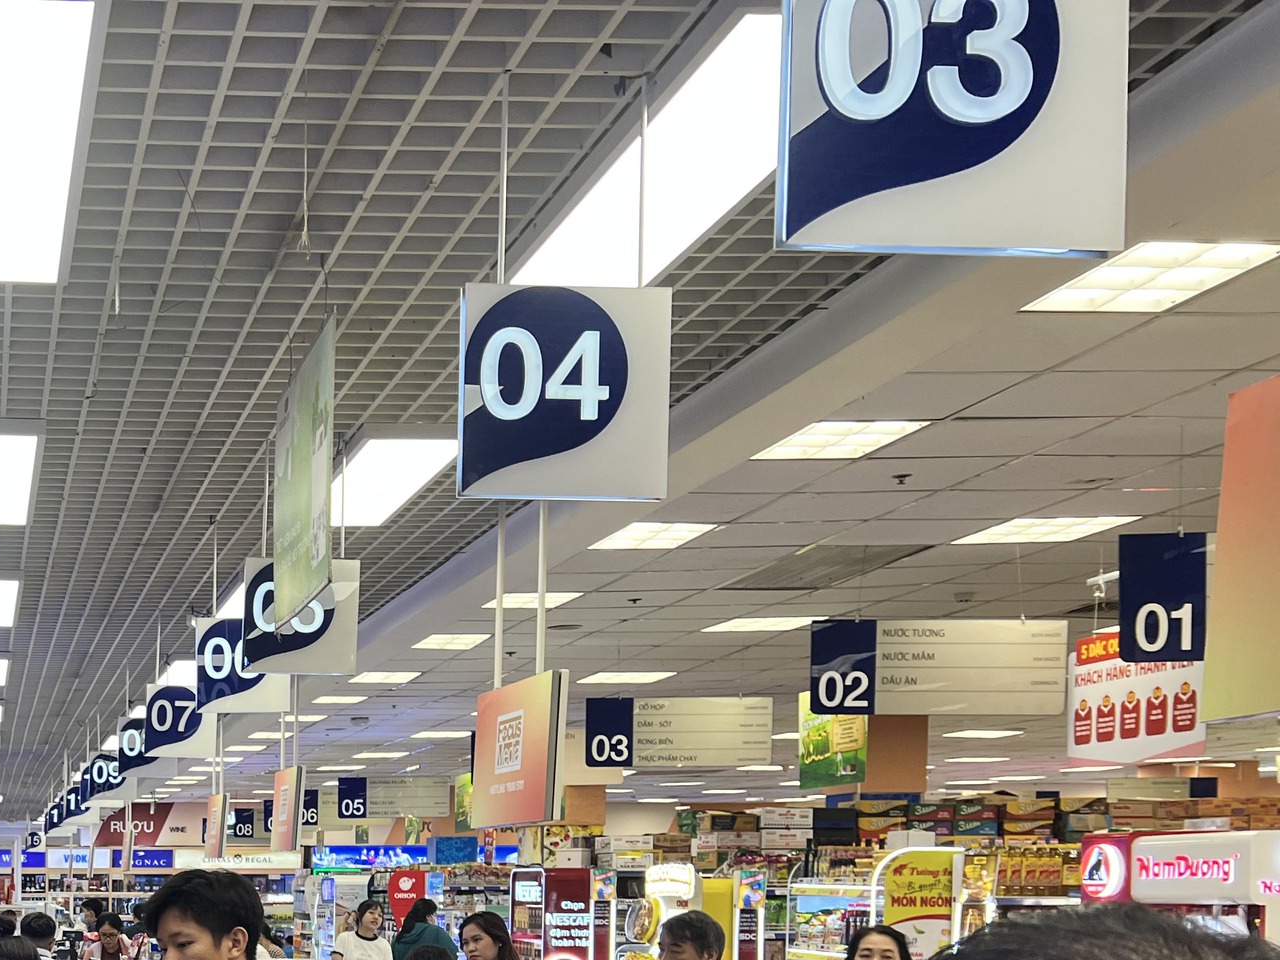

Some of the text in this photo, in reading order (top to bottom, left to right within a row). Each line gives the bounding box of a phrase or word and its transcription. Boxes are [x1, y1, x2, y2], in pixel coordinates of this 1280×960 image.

[817, 0, 1035, 124] 03
[480, 327, 610, 421] 04
[882, 627, 946, 638] NƯỚC TƯƠNG
[1134, 602, 1194, 652] 01
[882, 650, 910, 661] NƯỚC
[1081, 643, 1088, 660] 5
[1105, 664, 1132, 682] HÀNG
[819, 670, 869, 708] 02
[150, 698, 197, 733] 07
[591, 734, 629, 762] 03
[637, 738, 657, 746] RONG
[679, 755, 698, 763] CHAY
[92, 760, 123, 784] 09
[341, 799, 364, 816] 05
[169, 826, 187, 834] WINE
[236, 823, 253, 836] 08
[1, 853, 28, 863] WE
[63, 853, 89, 863] VDK
[119, 859, 167, 867] CGNAC
[245, 856, 274, 864] REGAL
[393, 891, 417, 899] ORION
[560, 900, 585, 911] Chọn
[545, 912, 591, 926] NESCAF
[739, 932, 757, 941] SDC
